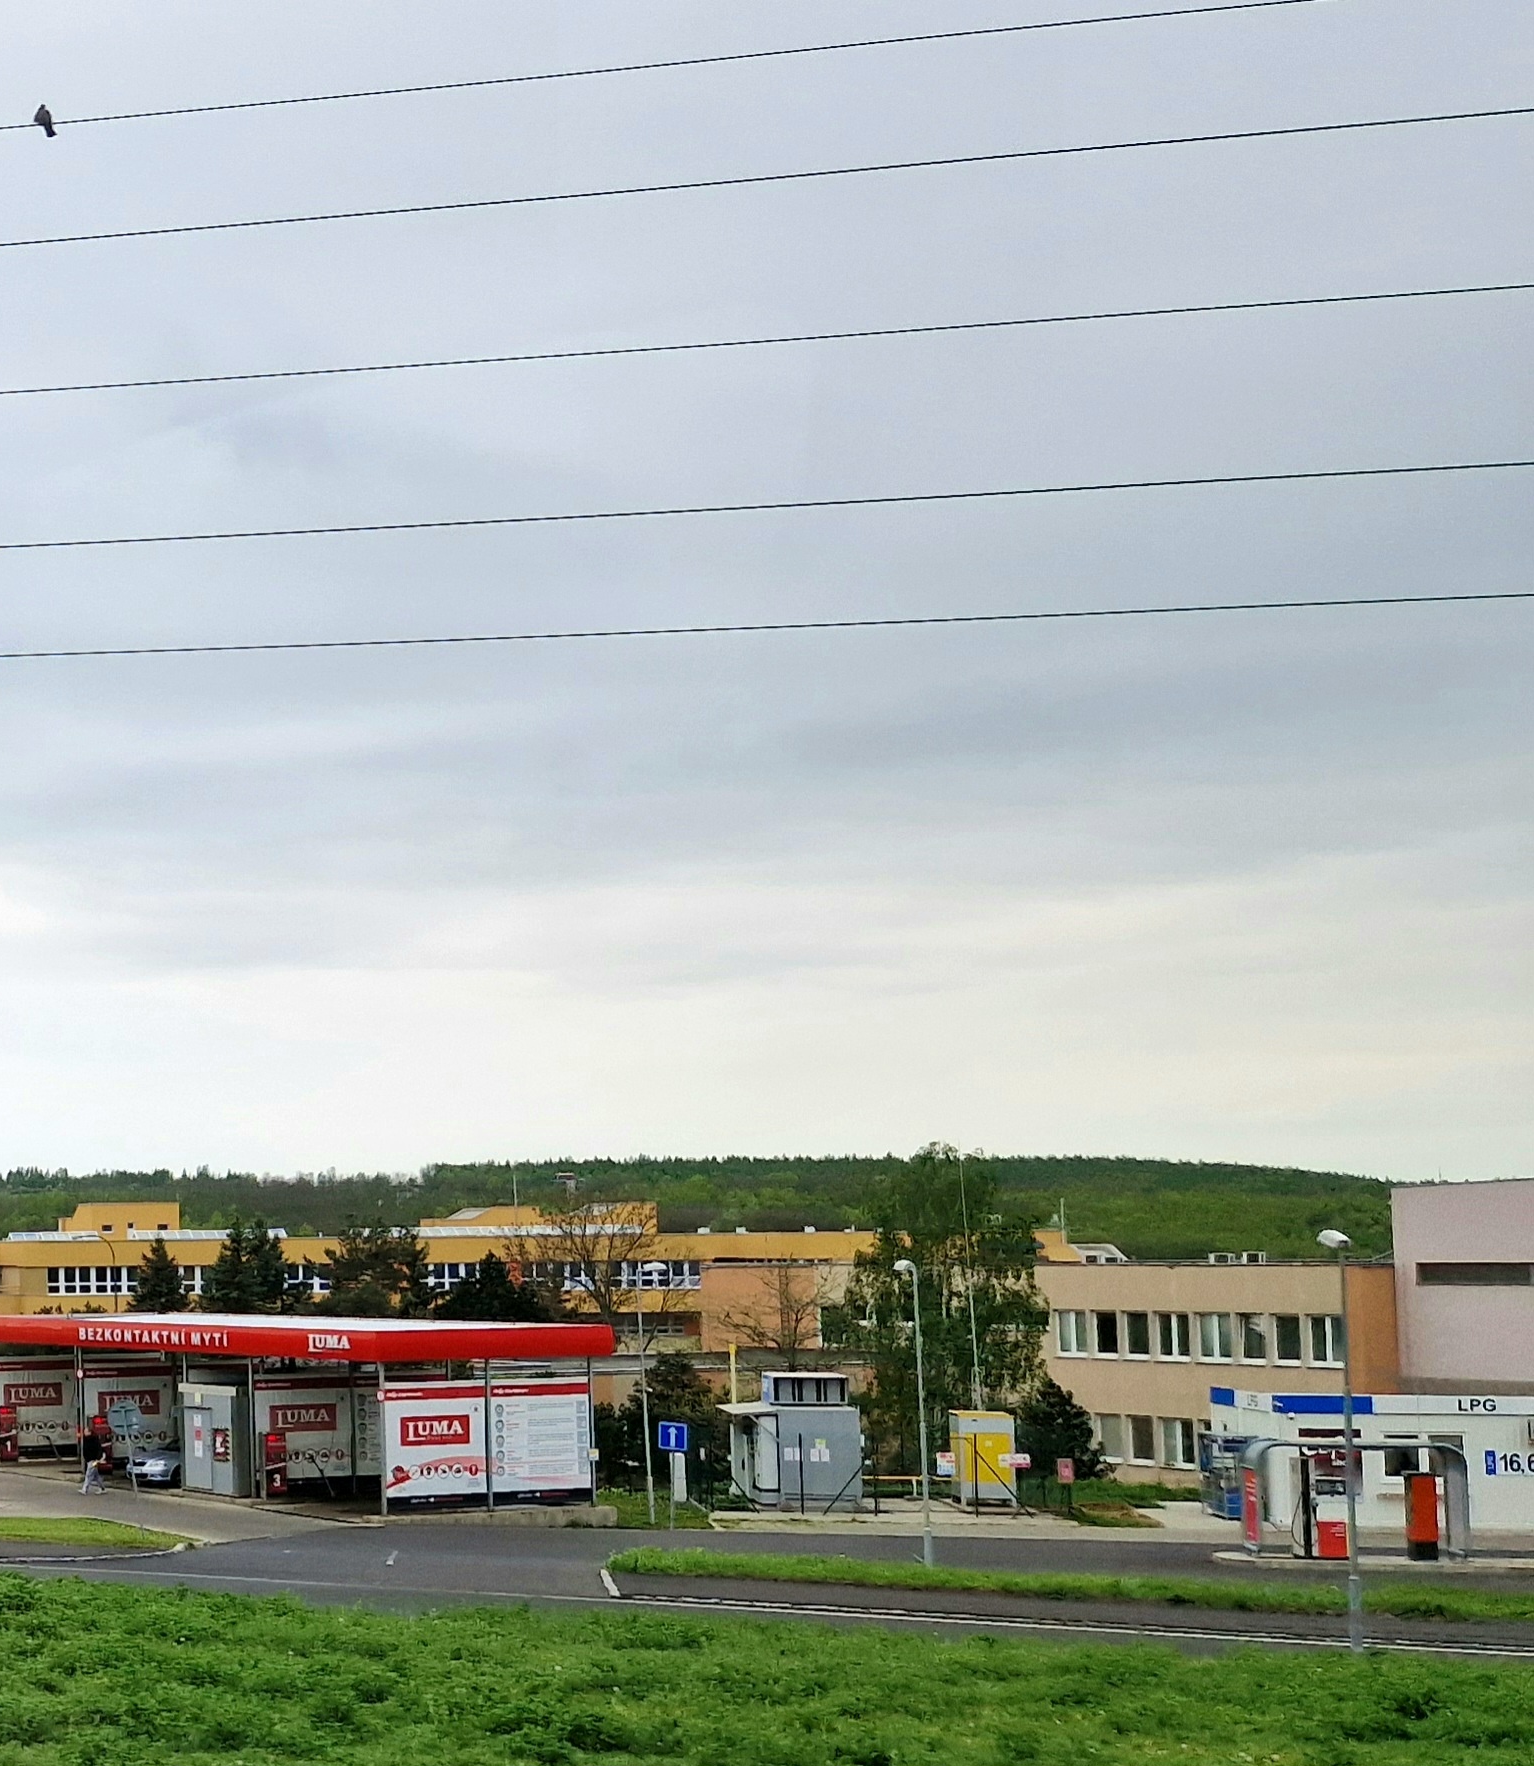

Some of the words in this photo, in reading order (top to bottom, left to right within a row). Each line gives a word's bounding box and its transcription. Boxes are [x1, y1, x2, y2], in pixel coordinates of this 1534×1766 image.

[78, 1327, 186, 1345] BEZKONTAKTNÍ
[190, 1329, 228, 1347] MYTÍ
[307, 1334, 351, 1352] LUMA
[9, 1387, 57, 1403] LUMA
[1458, 1398, 1497, 1412] LPG
[276, 1408, 330, 1428] LUMA
[406, 1420, 464, 1441] LUMA
[6, 1440, 11, 1452] 1
[273, 1474, 281, 1487] 3
